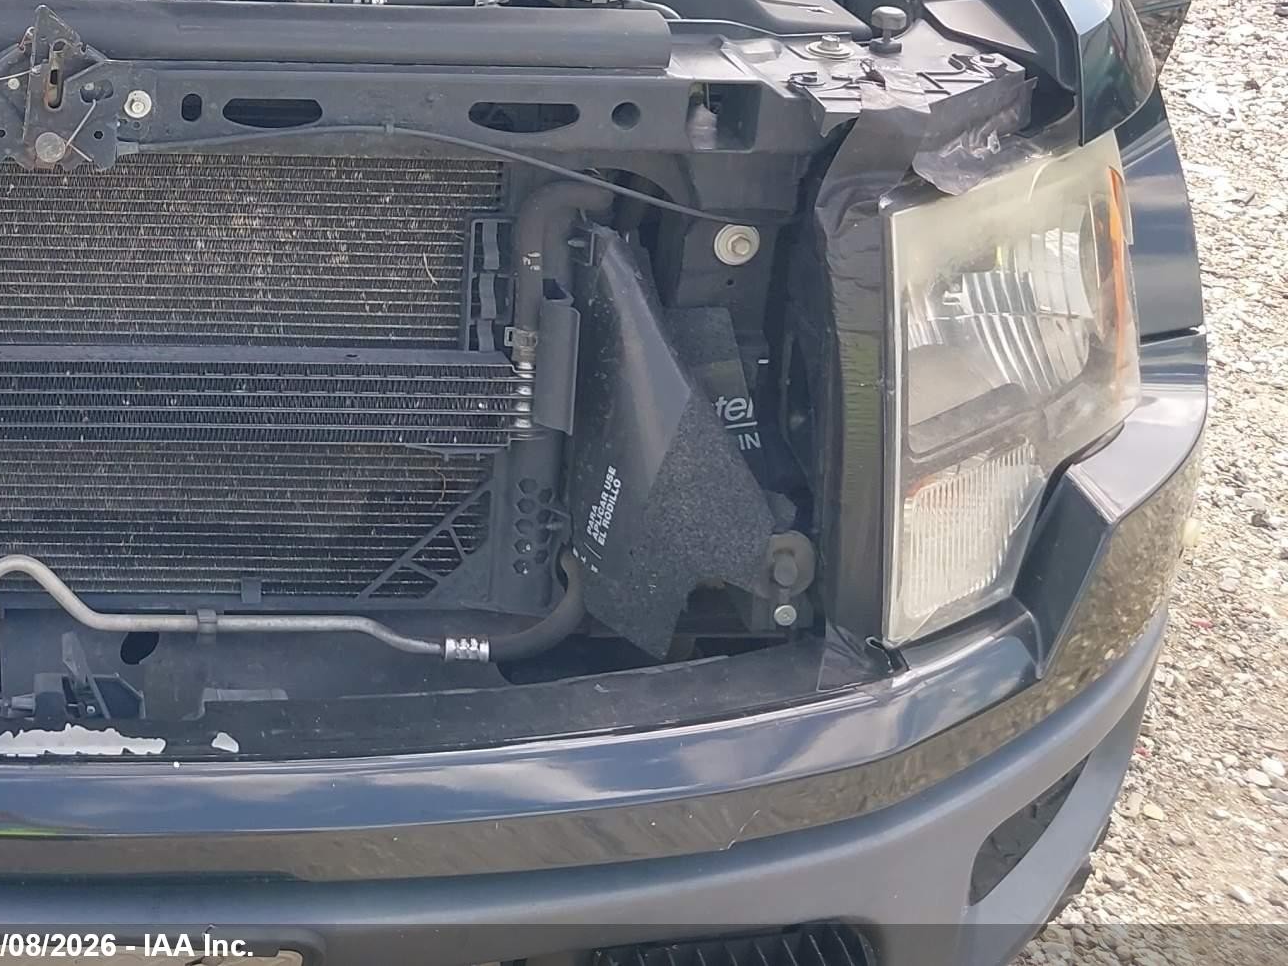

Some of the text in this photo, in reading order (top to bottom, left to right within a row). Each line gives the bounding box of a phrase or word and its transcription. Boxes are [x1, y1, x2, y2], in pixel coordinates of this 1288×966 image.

[738, 432, 761, 450] IN
[586, 505, 598, 535] PARA
[591, 465, 617, 542] APLICAR USE
[597, 478, 622, 547] EL RODILLO
